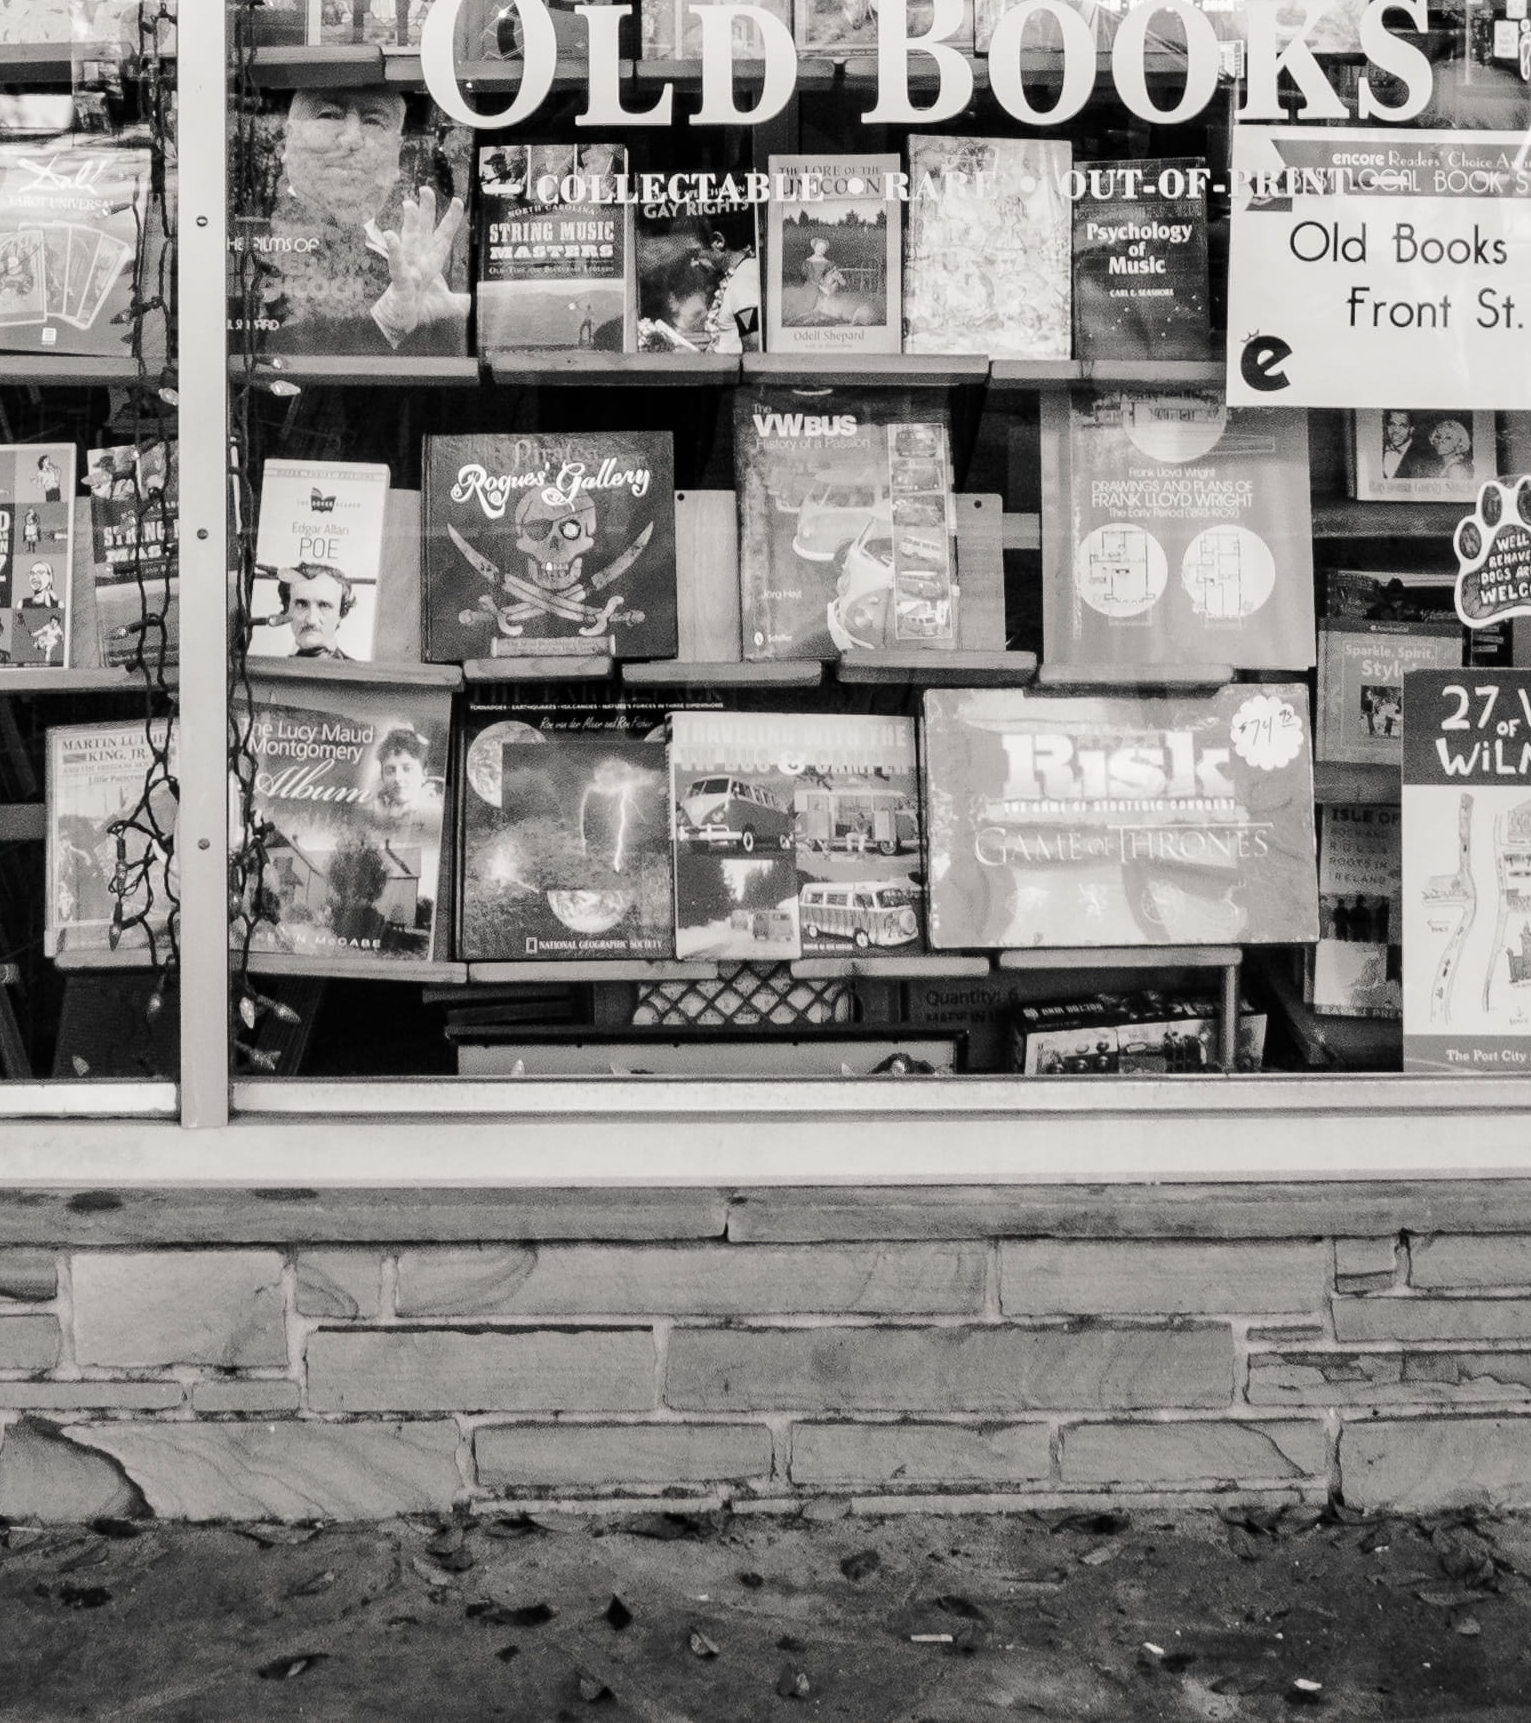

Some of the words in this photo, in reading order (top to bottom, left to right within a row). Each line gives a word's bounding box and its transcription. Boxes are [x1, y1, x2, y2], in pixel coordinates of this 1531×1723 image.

[536, 170, 824, 204] COLLECTABLE
[882, 170, 996, 203] RARE
[1065, 168, 1351, 204] OUT-OF-PRINT
[488, 223, 554, 243] STRING
[561, 221, 614, 241] MUSIC
[1085, 222, 1192, 245] Psychology
[1289, 220, 1367, 263] Old
[1392, 222, 1508, 264] Books
[1128, 242, 1146, 257] of
[1109, 256, 1166, 275] Music
[1347, 286, 1452, 328] Front
[1475, 287, 1524, 329] St.
[1091, 493, 1136, 508] FRANK
[1141, 493, 1191, 508] LLOYD
[1195, 493, 1253, 508] WRIGHT
[299, 537, 339, 559] POE
[1496, 533, 1530, 552] WELL
[1480, 567, 1511, 585] DOGS
[1440, 684, 1500, 730] 27
[278, 721, 318, 743] Lucy
[322, 723, 374, 743] Maud
[1496, 720, 1520, 737] OF
[247, 737, 363, 764] Montgomery
[253, 758, 371, 803] Album
[539, 939, 577, 950] NATIONAL
[579, 939, 628, 950] GEOGRAPHIC
[631, 939, 662, 949] SOCIETY
[1446, 1050, 1468, 1062] The
[1473, 1050, 1499, 1062] Port
[1502, 1049, 1527, 1063] City
